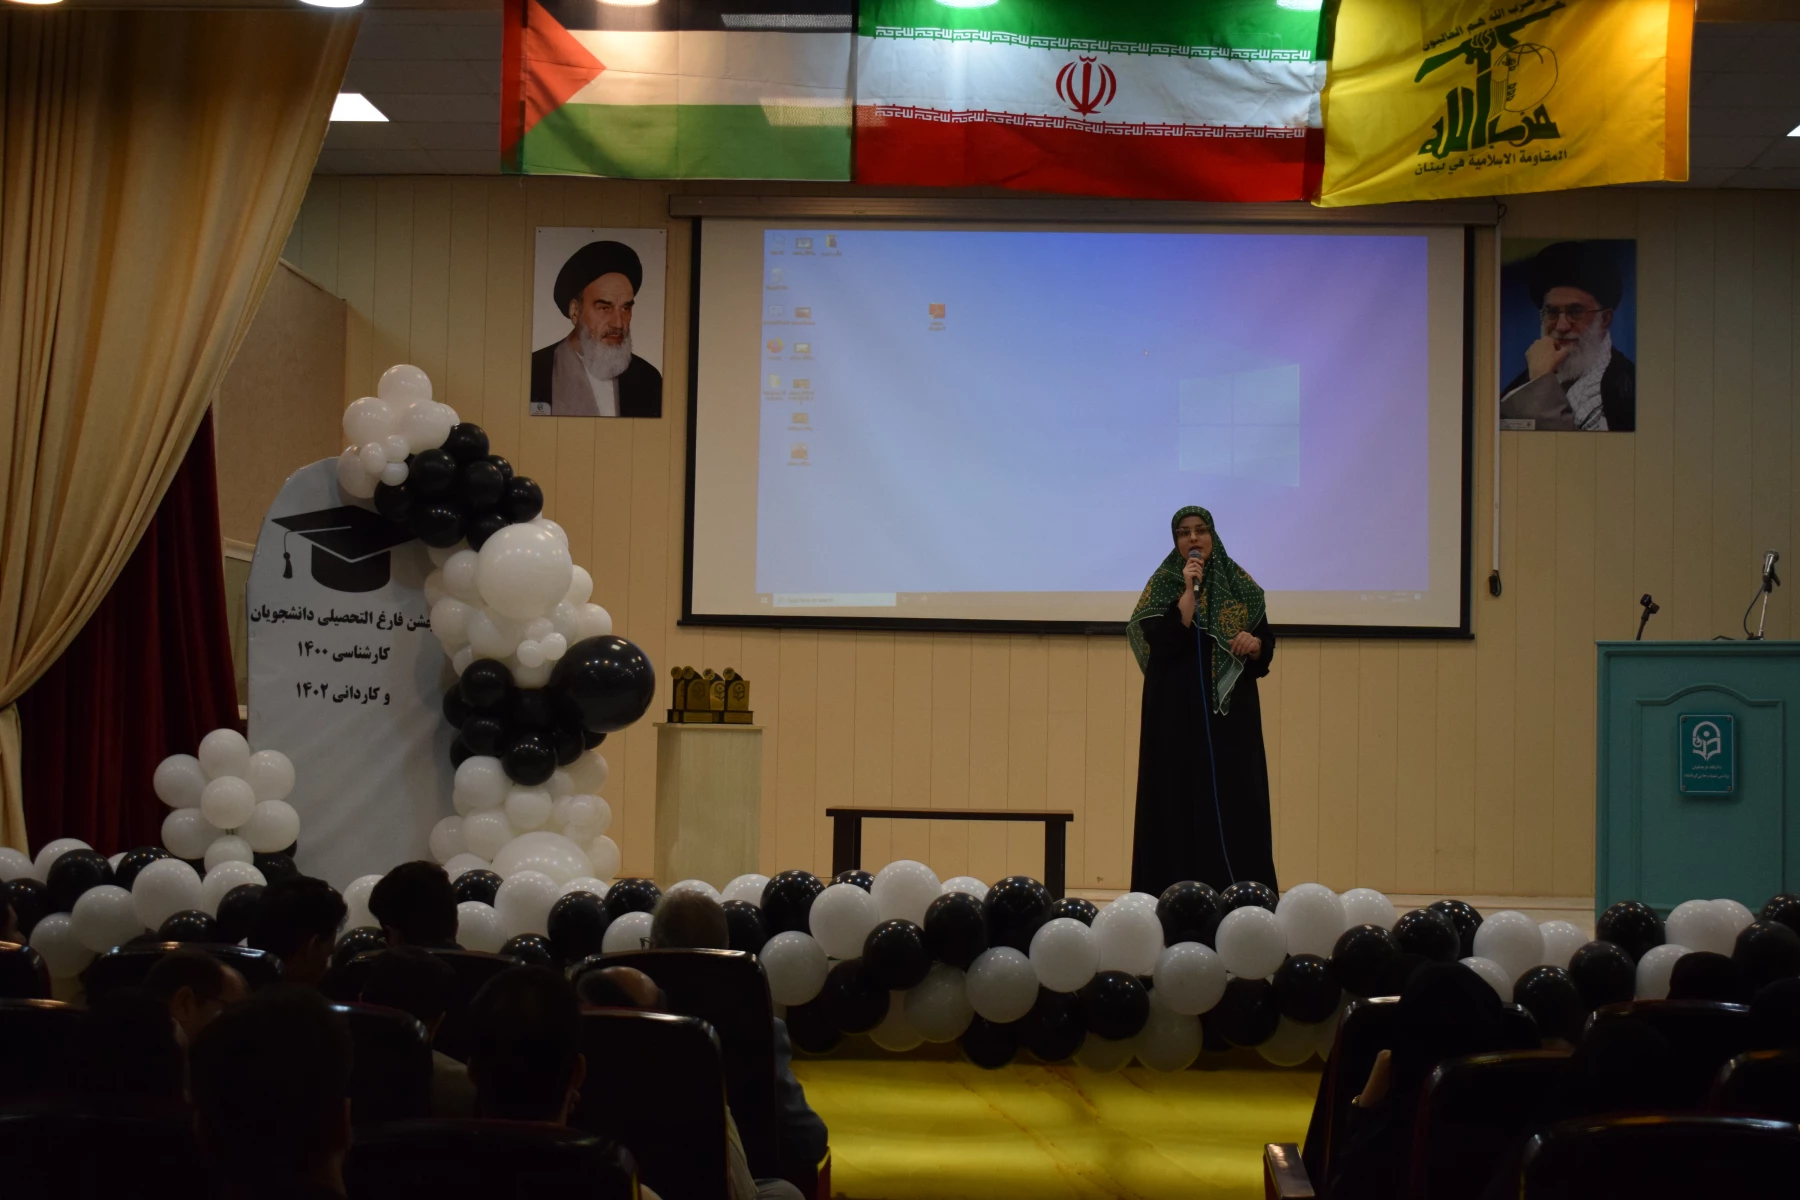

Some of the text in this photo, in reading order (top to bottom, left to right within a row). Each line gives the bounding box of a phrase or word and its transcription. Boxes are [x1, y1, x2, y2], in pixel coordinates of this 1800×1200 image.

[250, 604, 314, 624] دانشجویان
[317, 609, 373, 626] التحصیلی
[376, 611, 403, 630] فارغ
[298, 641, 390, 664] کارشناسی ۱۴۰۰
[296, 682, 390, 705] و کاردانی ۱۴۰۲
